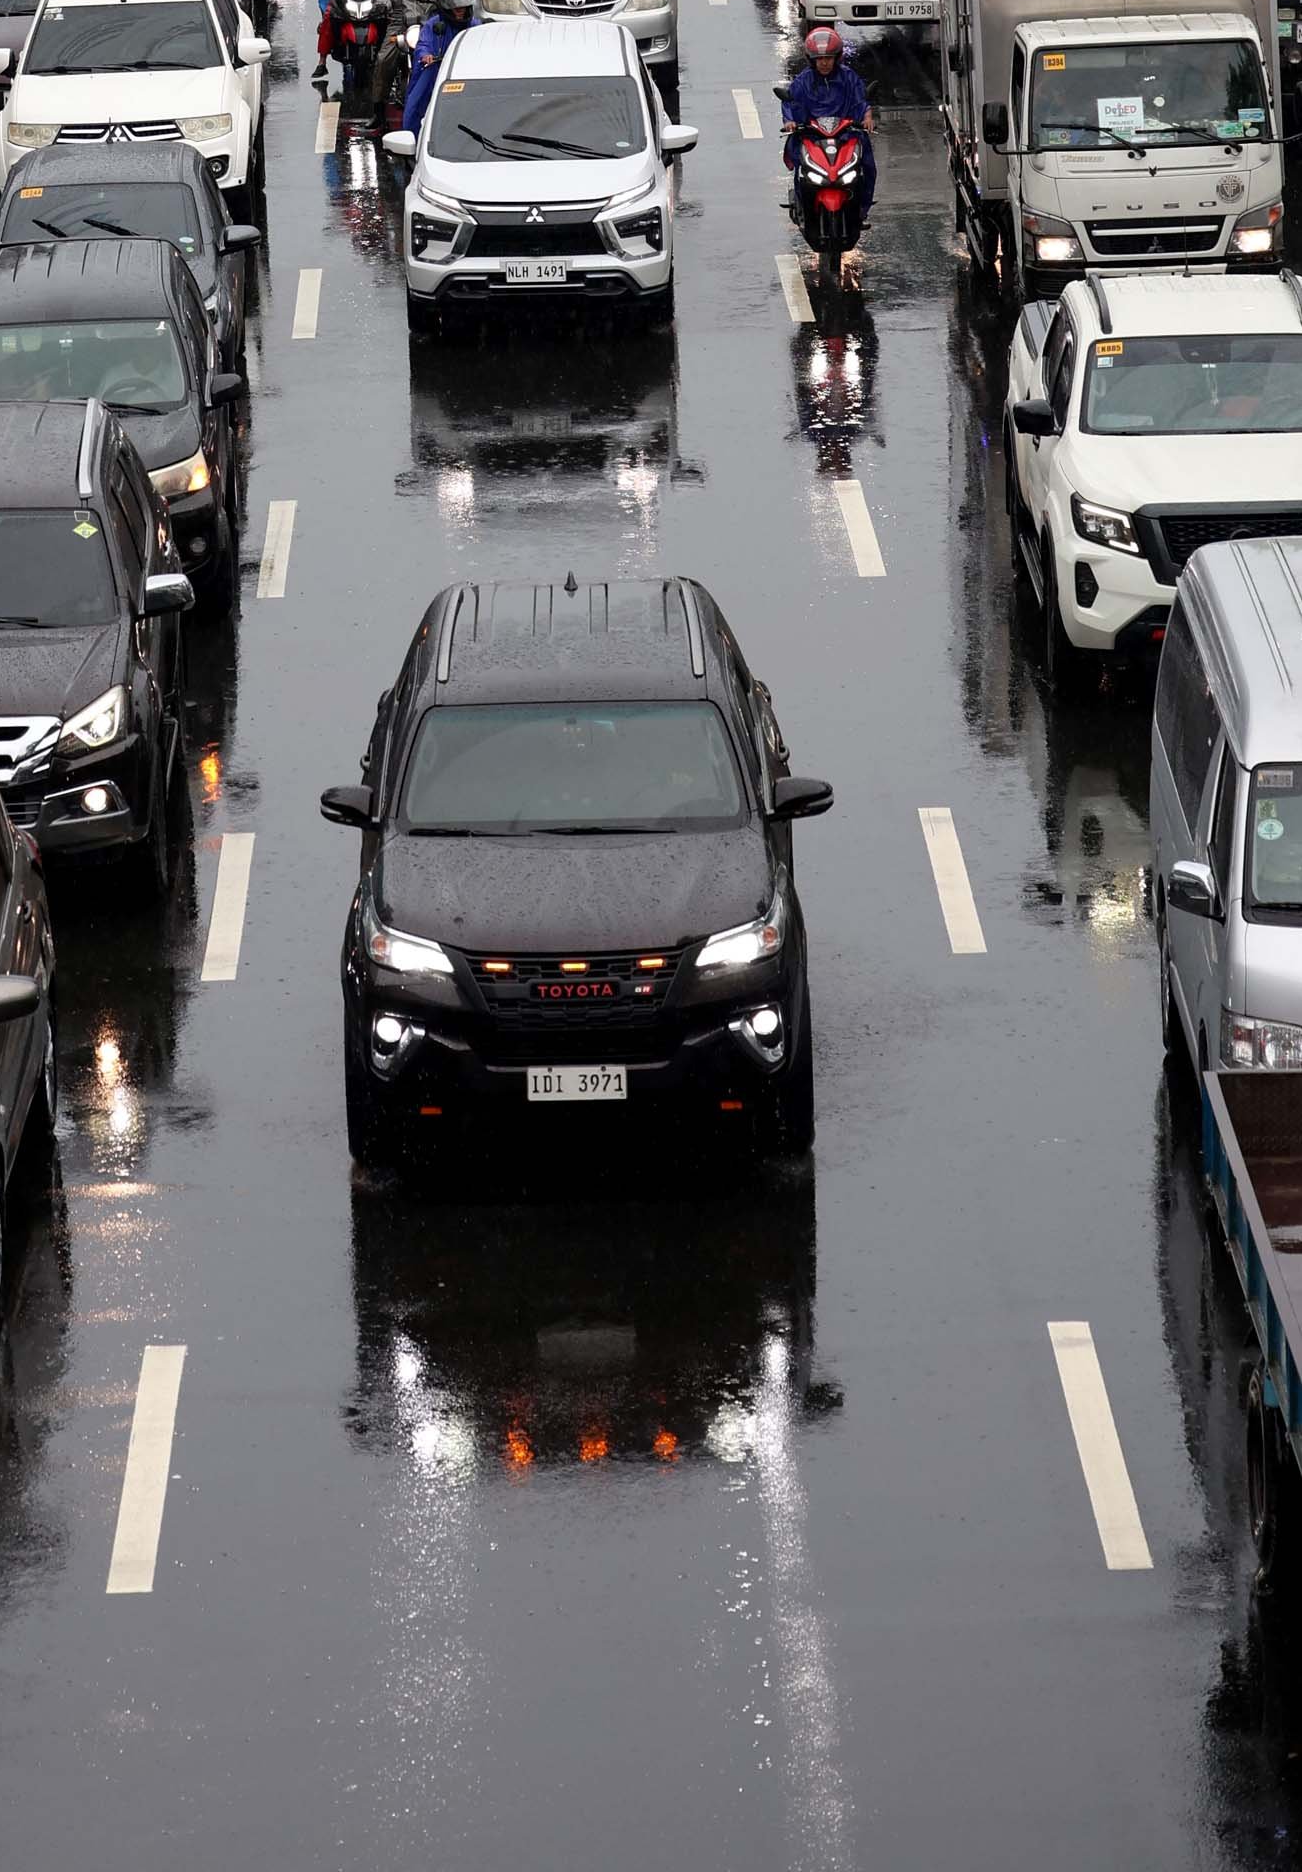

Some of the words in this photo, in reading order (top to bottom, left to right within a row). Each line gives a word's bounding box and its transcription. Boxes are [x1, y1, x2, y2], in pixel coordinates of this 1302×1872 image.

[887, 5, 904, 16] NID
[909, 5, 932, 15] 9758
[508, 266, 529, 278] NLH
[536, 265, 565, 278] 1491
[537, 983, 613, 998] TOYOTA
[532, 1074, 564, 1094] IDI
[578, 1073, 624, 1093] 3971
